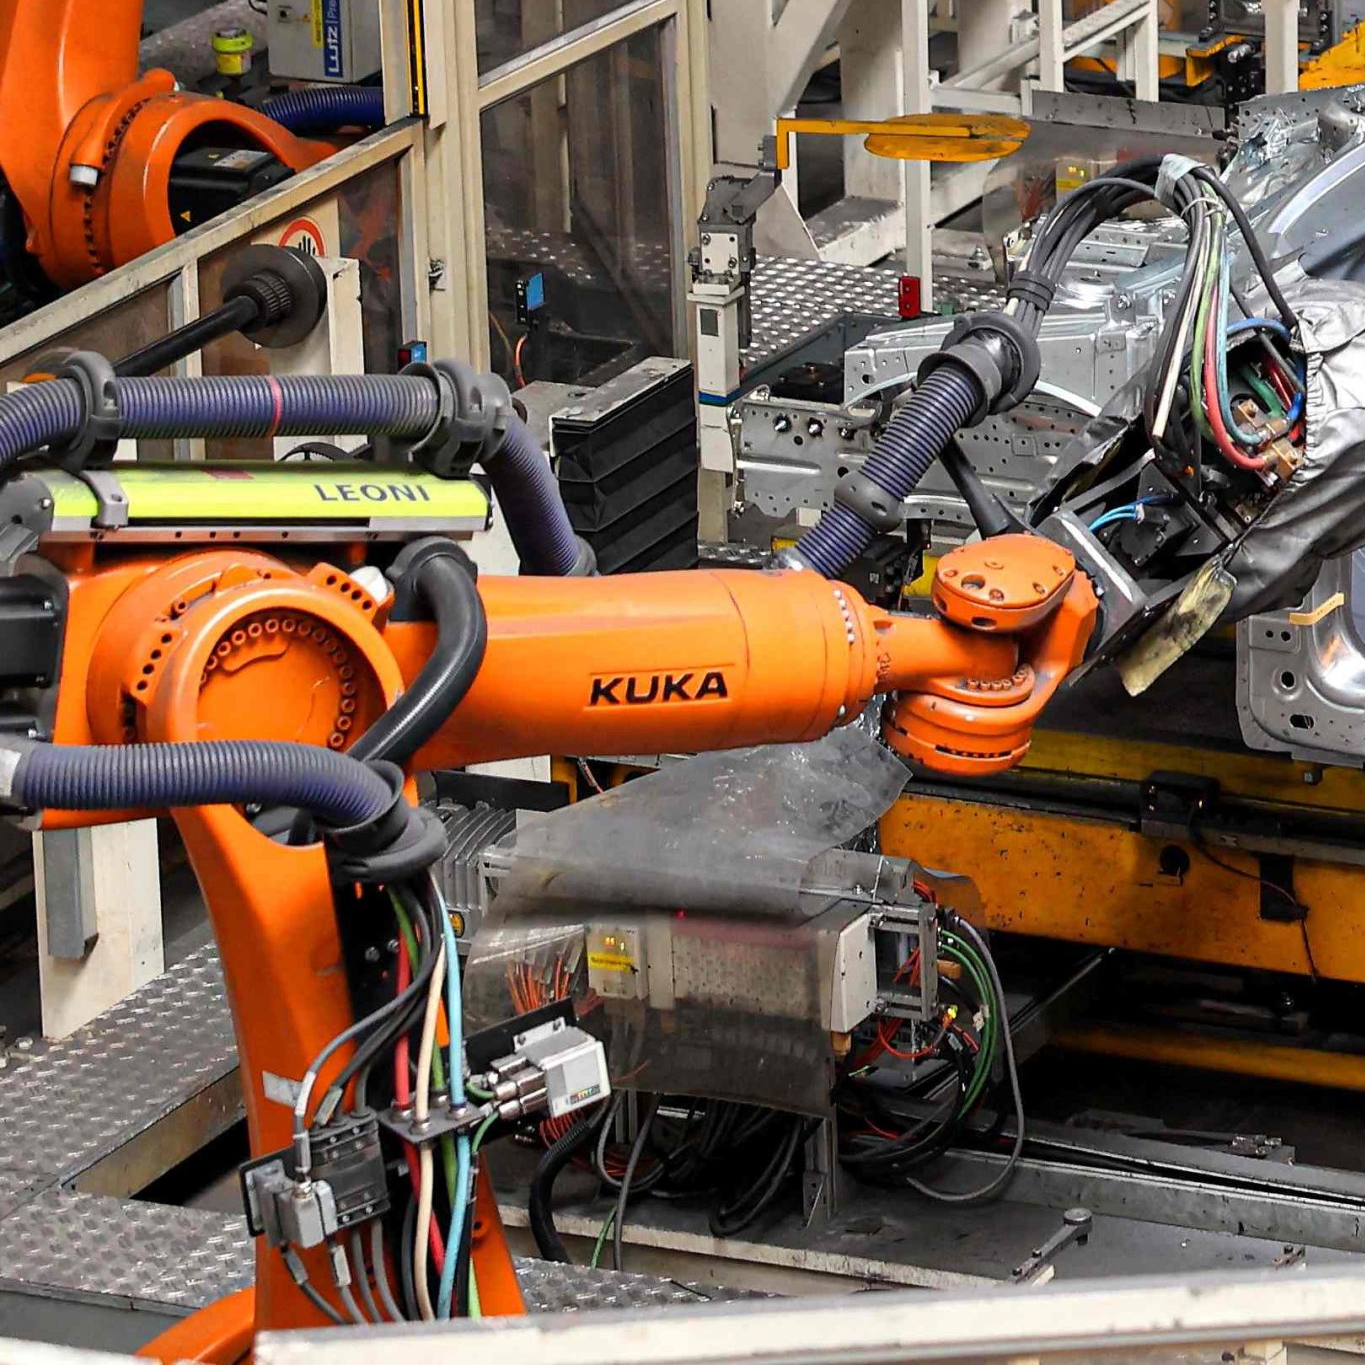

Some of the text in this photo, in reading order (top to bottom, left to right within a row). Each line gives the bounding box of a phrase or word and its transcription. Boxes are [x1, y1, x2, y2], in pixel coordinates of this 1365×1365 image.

[327, 26, 340, 73] Lutz
[314, 484, 430, 501] LEONI
[589, 671, 729, 707] KUKA
